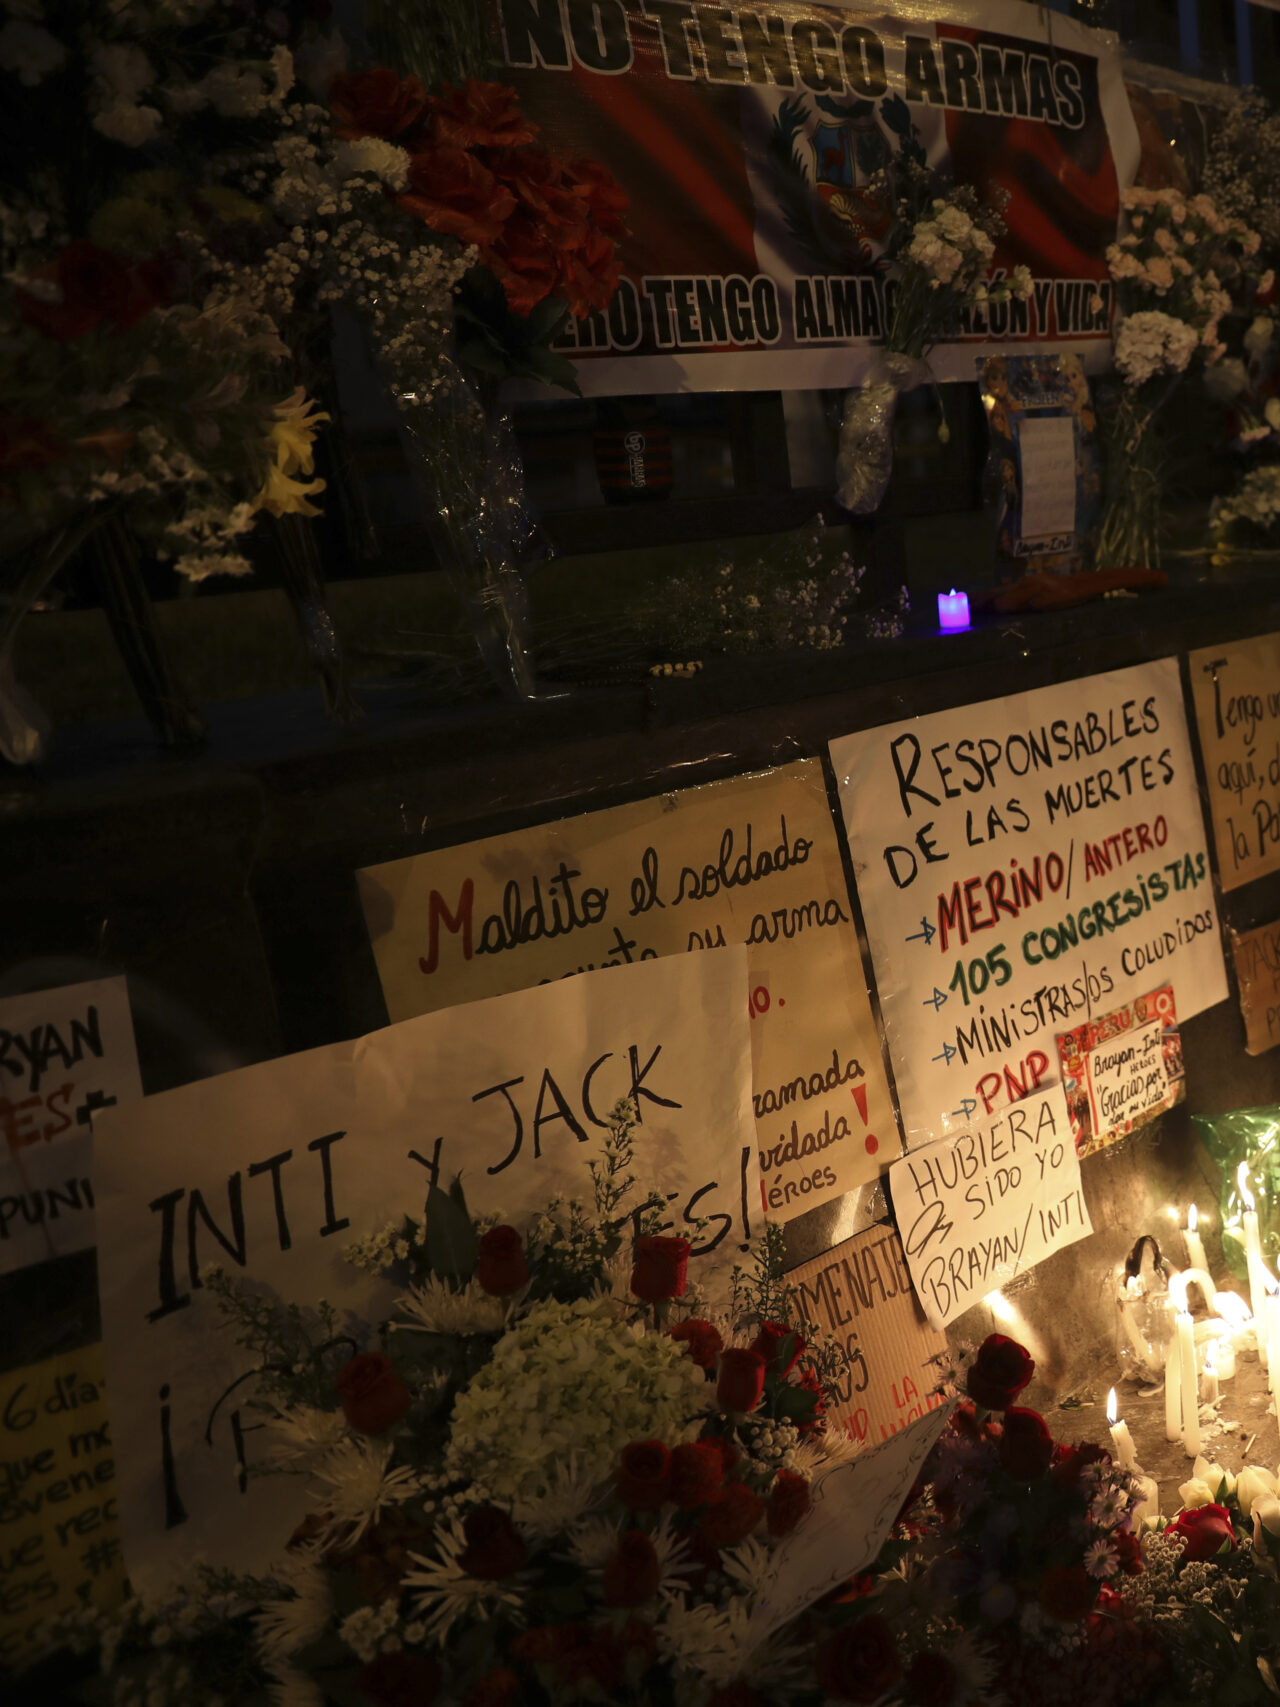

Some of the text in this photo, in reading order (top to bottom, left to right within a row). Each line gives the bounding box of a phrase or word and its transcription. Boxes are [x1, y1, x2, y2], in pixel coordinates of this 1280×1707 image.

[499, 0, 1086, 130] NO TENGO ARMAS
[549, 274, 643, 352] ERO
[641, 275, 779, 347] TENGO
[794, 276, 882, 341] ALMA
[1032, 279, 1053, 336] Y
[1054, 278, 1112, 336] VIDA
[1203, 657, 1263, 745] Tengo
[890, 697, 1160, 817] RESPONSABLES
[884, 748, 1175, 889] DE LAS MUERTES
[1227, 818, 1249, 870] la
[419, 861, 609, 975] Maldito
[628, 846, 666, 917] el
[671, 814, 814, 906] soldado
[744, 898, 850, 945] arma
[949, 851, 1206, 1006] 105 CONGRESISTAS
[1121, 909, 1213, 976] COLUDIDOS
[975, 1049, 1049, 1114] PNP
[147, 1131, 351, 1322] INTI
[472, 1044, 682, 1175] JACK
[908, 1101, 1057, 1207] HUBIERA
[965, 1143, 1065, 1221] SIDO YO
[3, 1372, 106, 1432] 6 dia
[892, 1375, 919, 1409] LA
